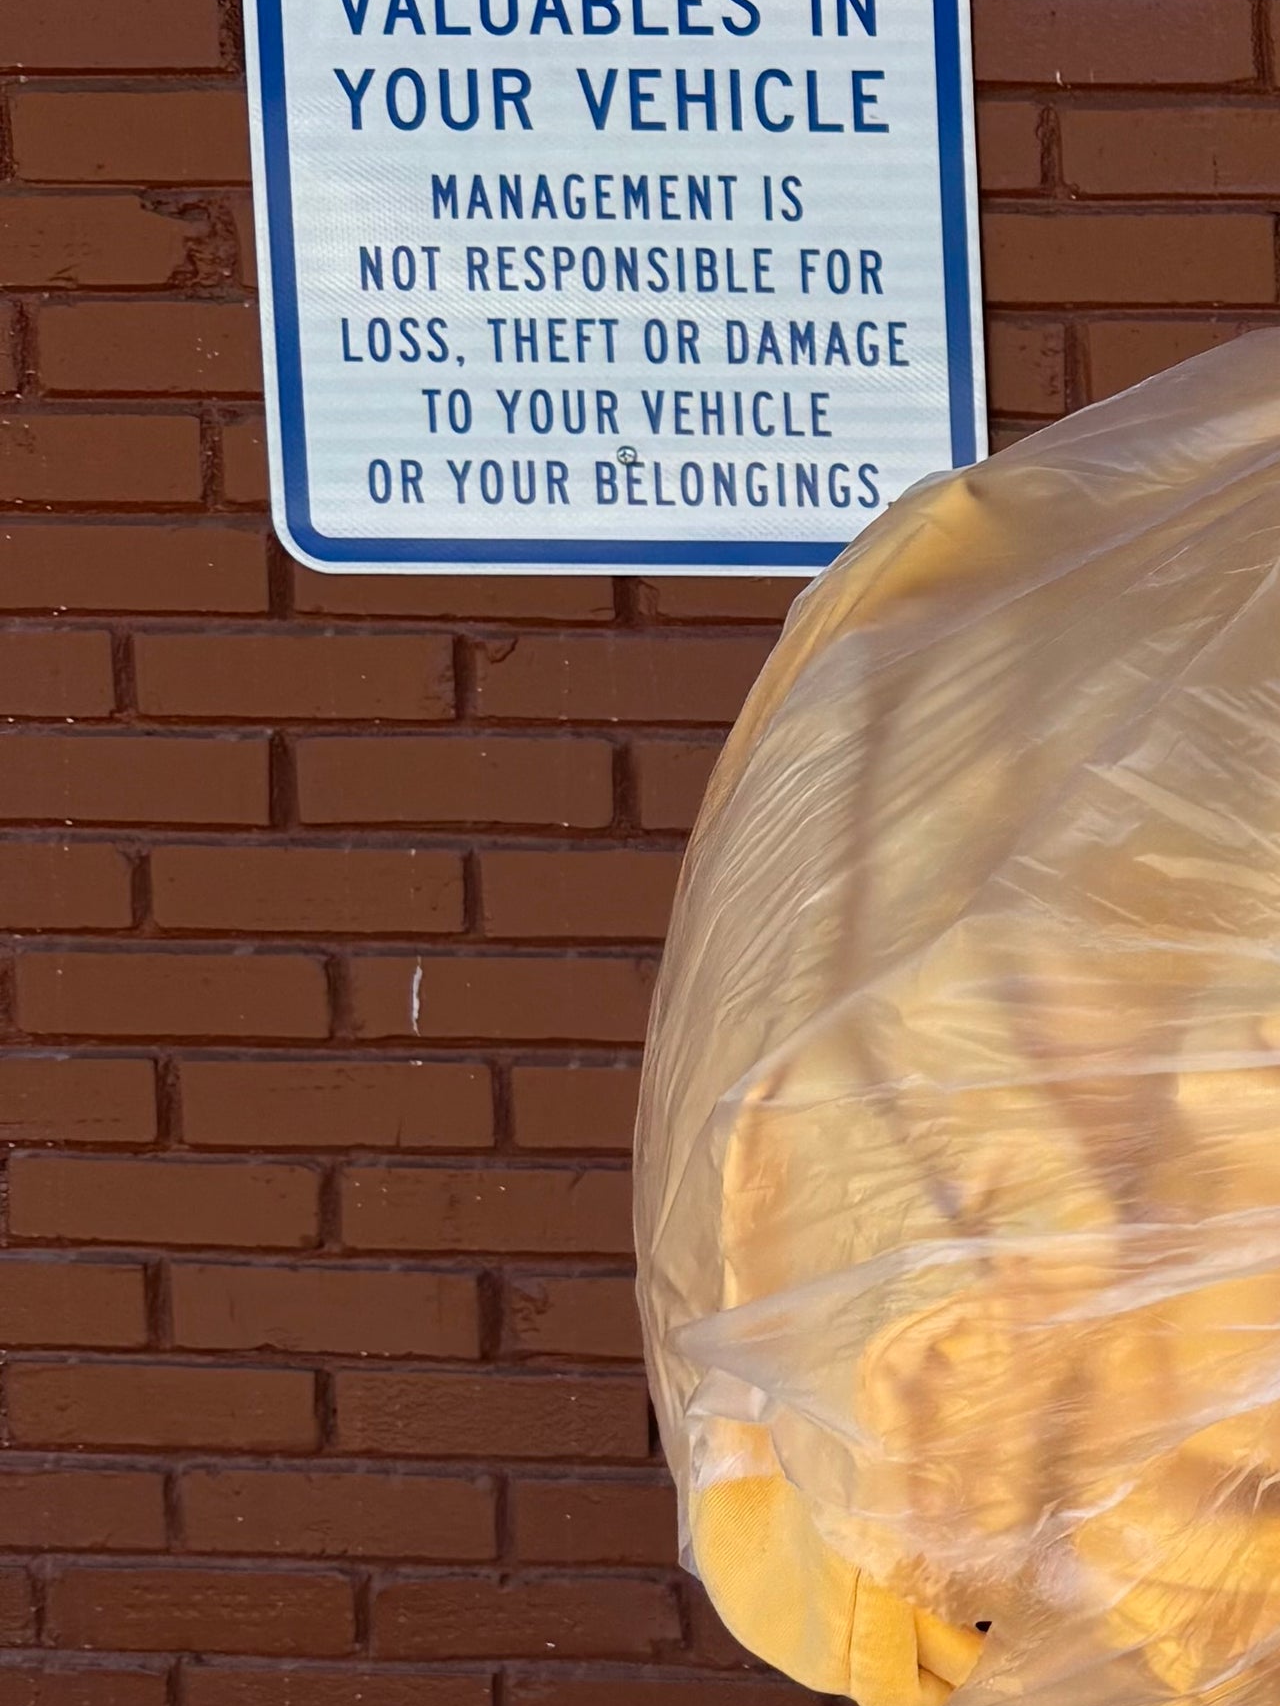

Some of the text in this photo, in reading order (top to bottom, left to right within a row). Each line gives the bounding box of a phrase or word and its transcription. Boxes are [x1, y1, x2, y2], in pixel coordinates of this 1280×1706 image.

[333, 67, 890, 133] YOUR VEHICLE
[431, 173, 803, 222] MANAGEMENT IS
[359, 245, 884, 295] NOT RESPONSIBLE FOR
[341, 317, 910, 367] LOSS, THEFT OR DAMAGE
[421, 388, 832, 438] TO YOUR VEHICLE
[367, 458, 425, 504] OR
[446, 459, 570, 505] YOUR
